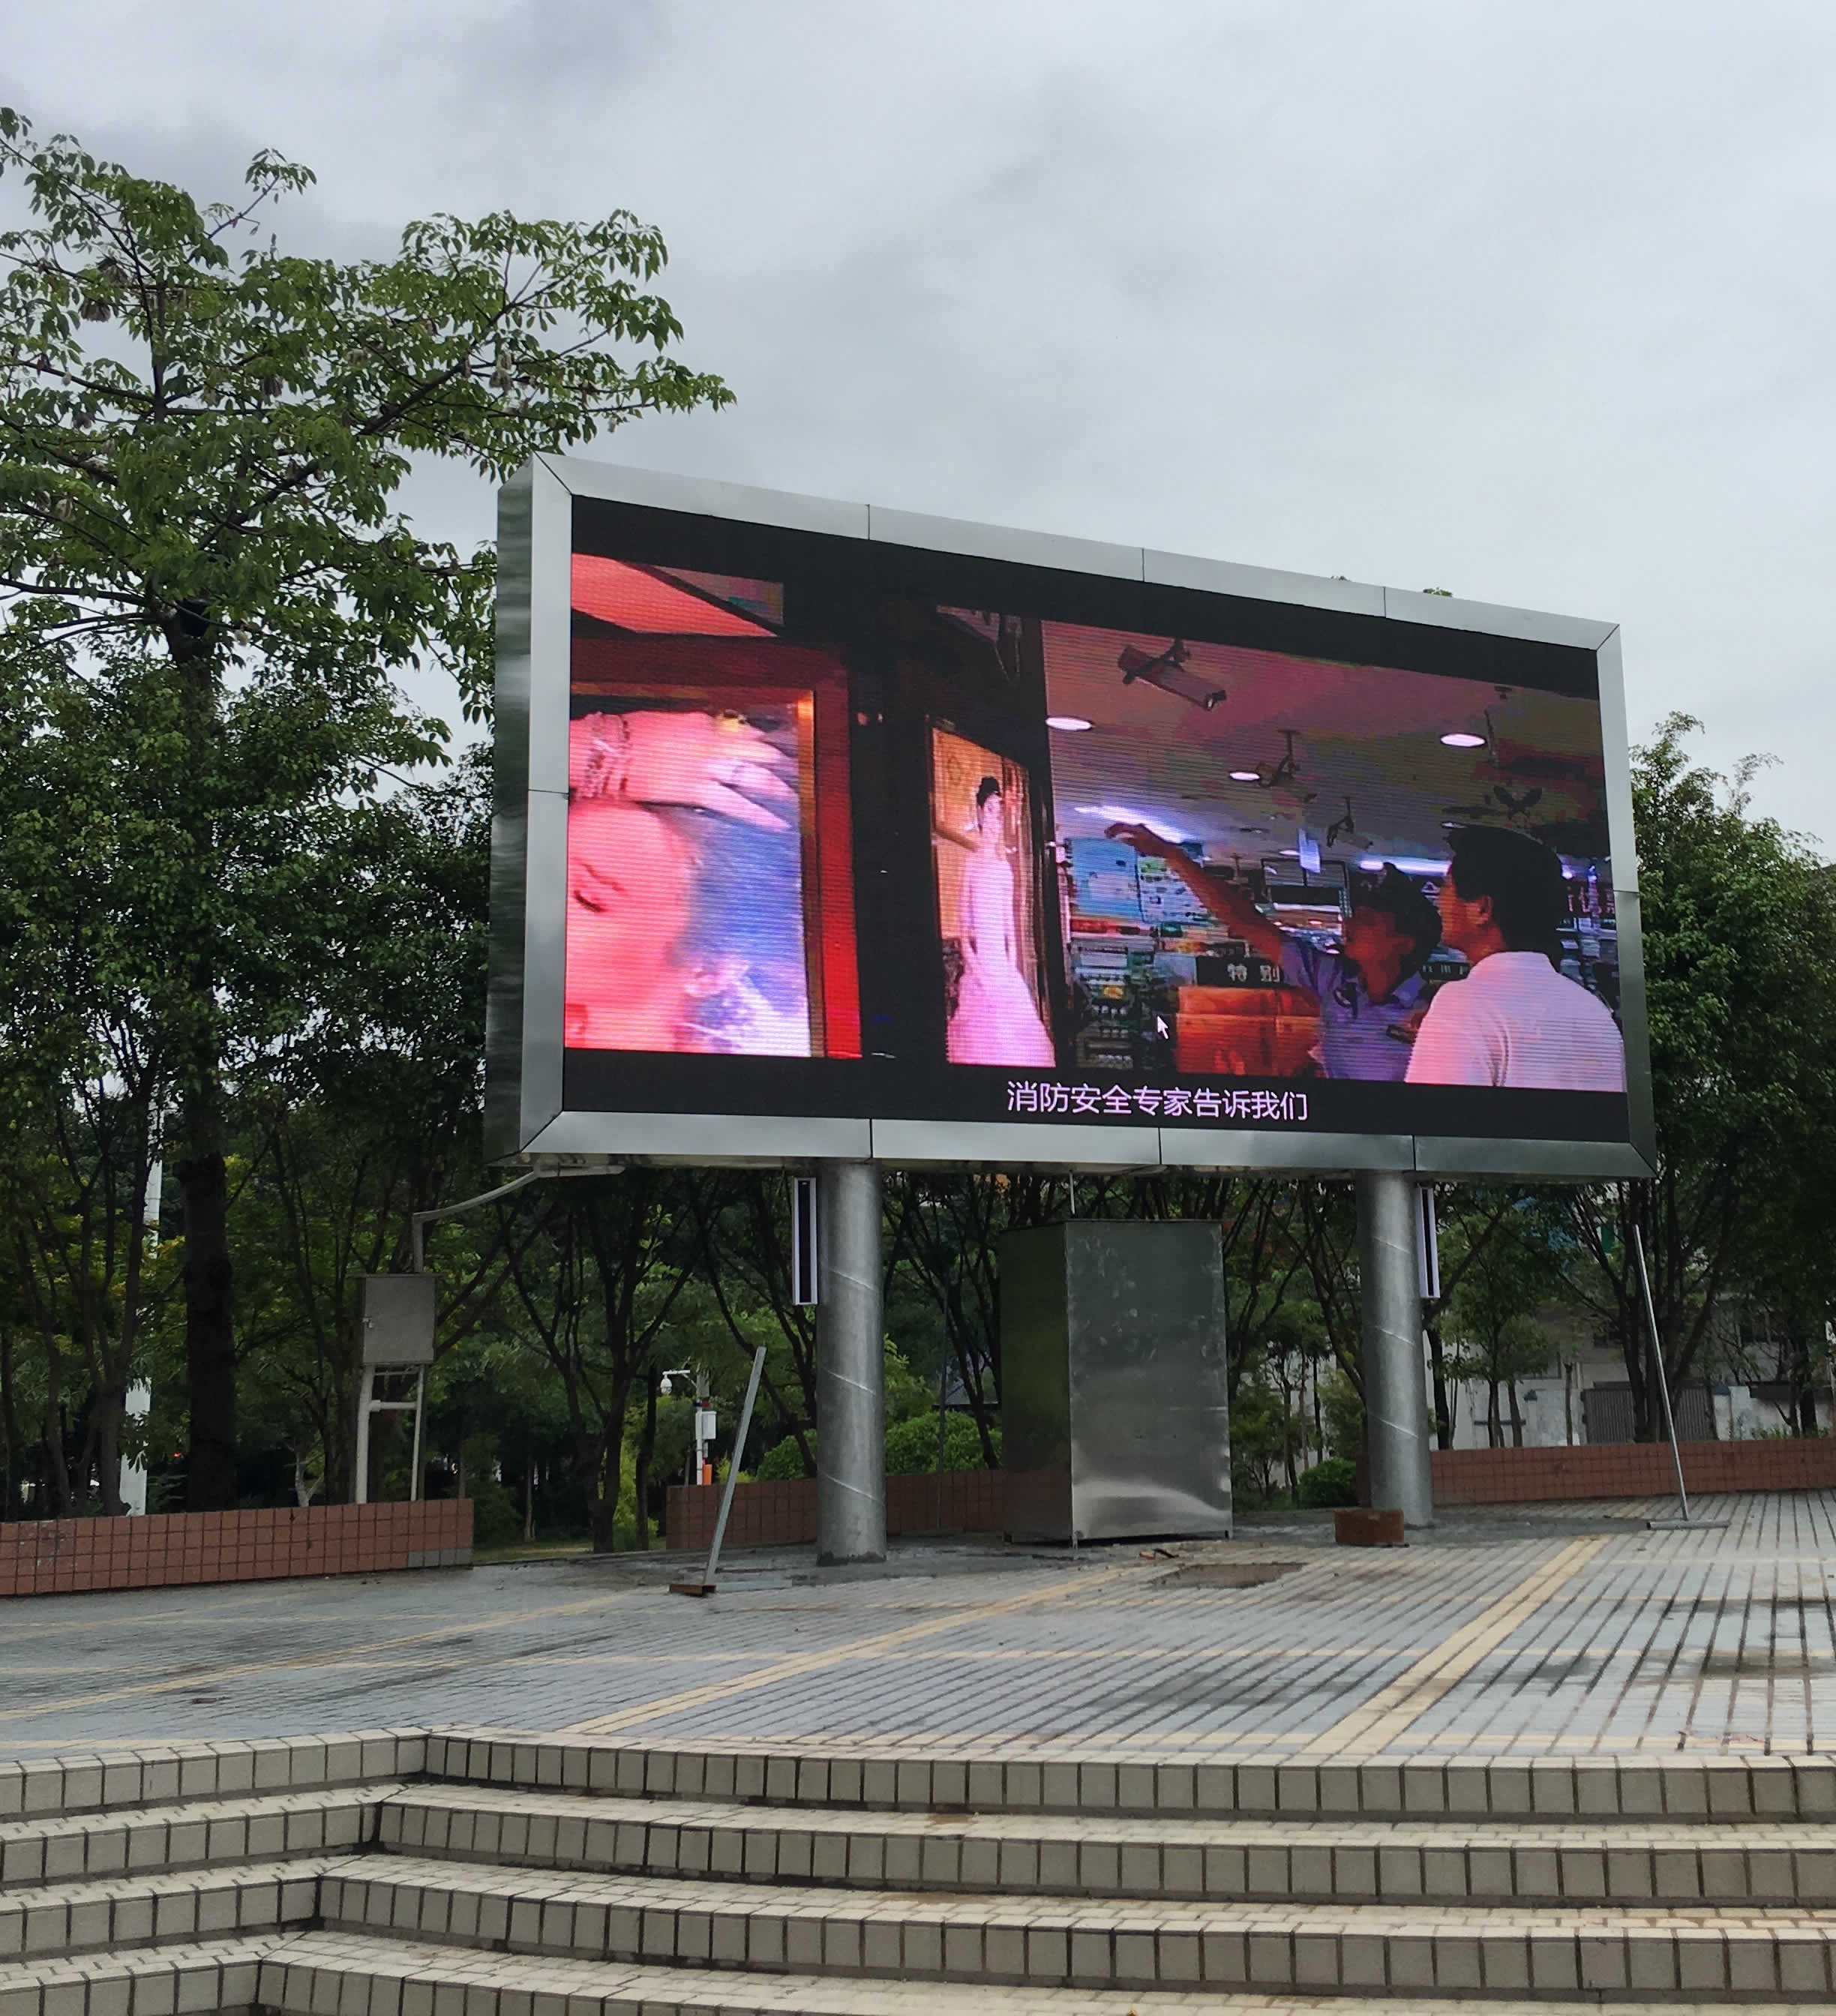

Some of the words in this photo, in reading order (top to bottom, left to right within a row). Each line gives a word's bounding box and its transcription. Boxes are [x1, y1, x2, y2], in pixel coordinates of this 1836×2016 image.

[1006, 1080, 1309, 1120] 消防安全专家告诉我们
